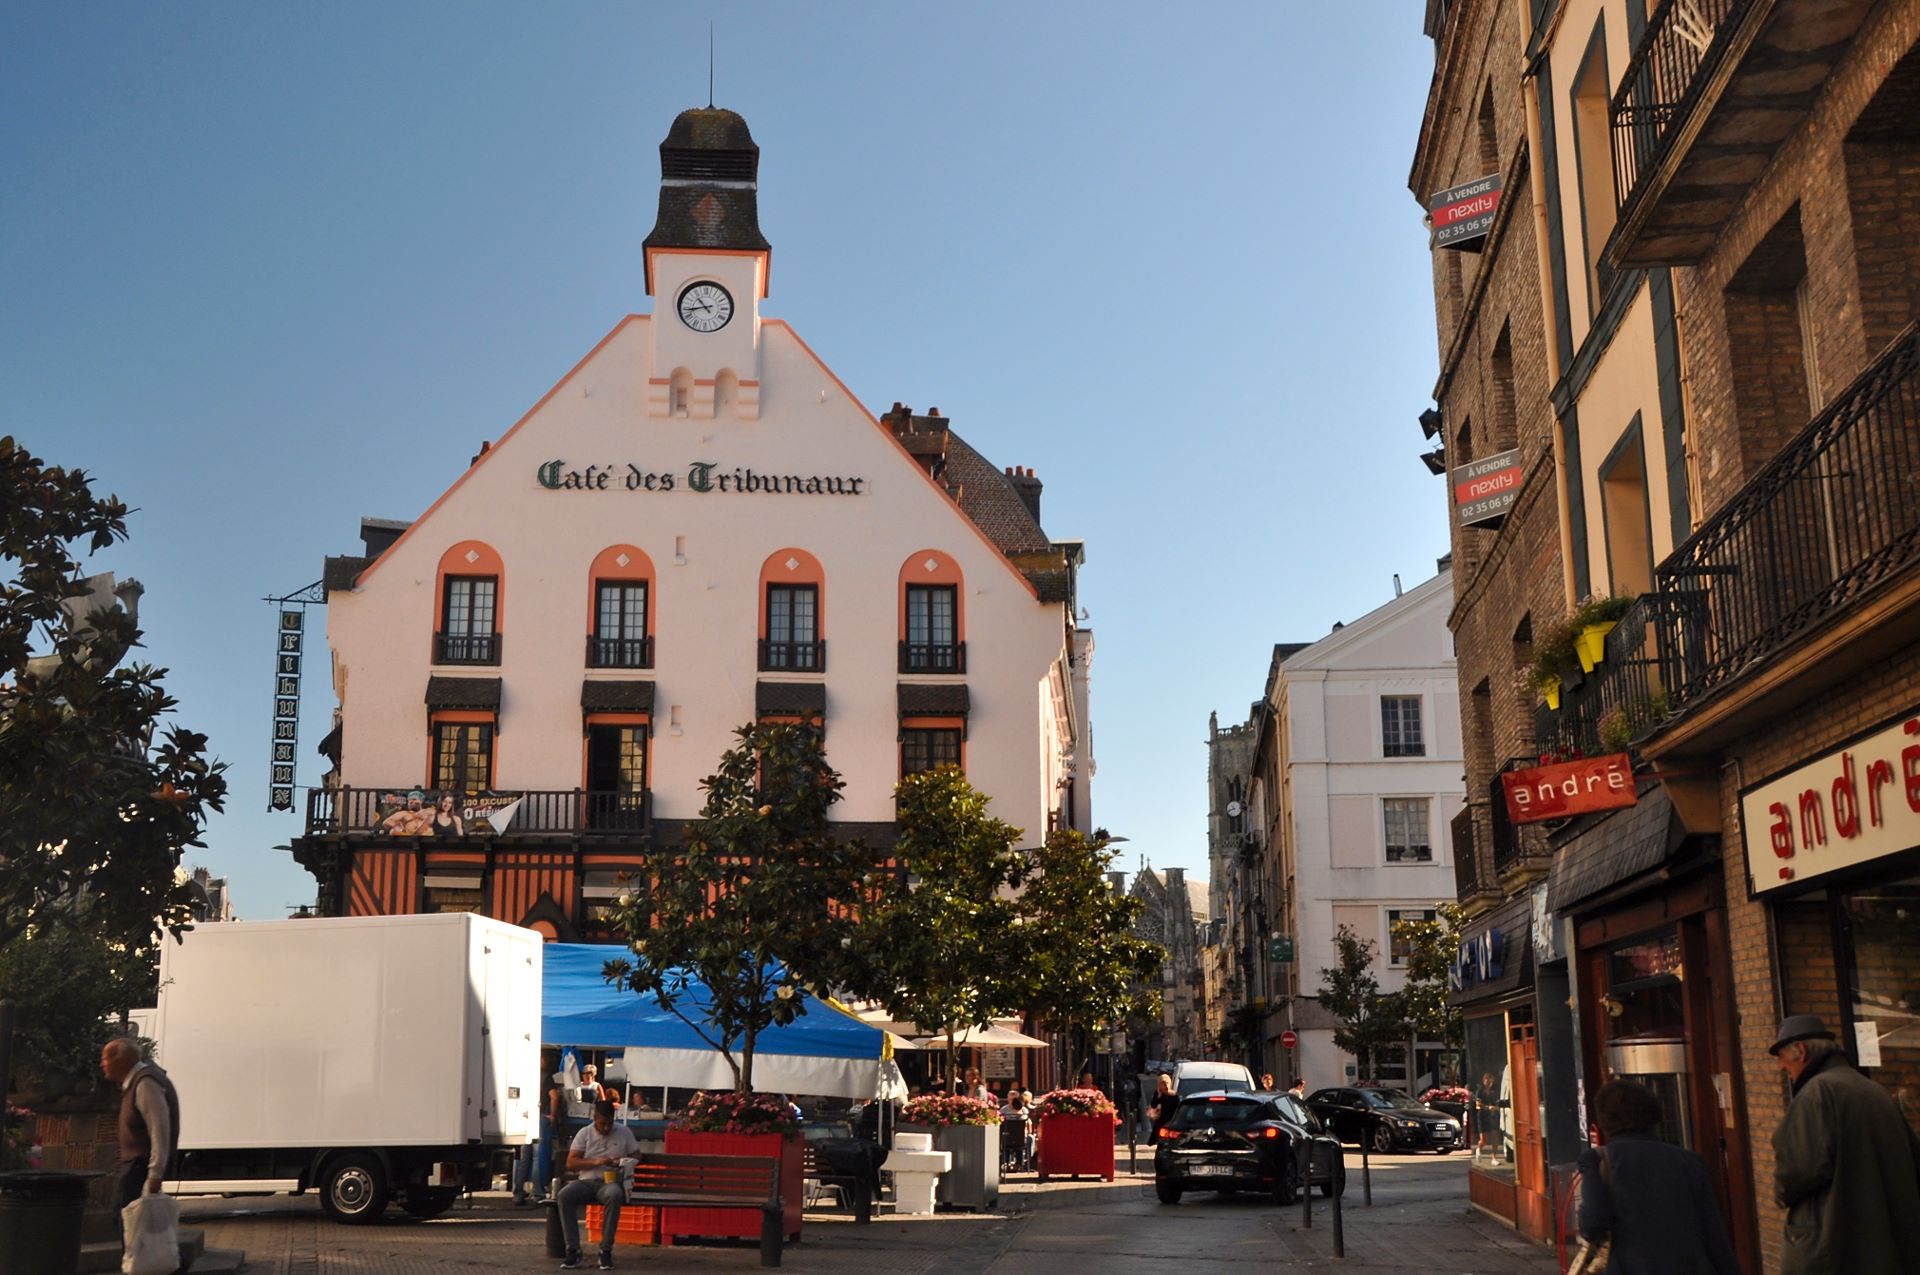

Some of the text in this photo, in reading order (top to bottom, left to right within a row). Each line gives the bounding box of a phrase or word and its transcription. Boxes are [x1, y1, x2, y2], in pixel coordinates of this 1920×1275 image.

[1455, 181, 1492, 200] VENDRE
[1448, 197, 1493, 220] nexity
[1438, 229, 1451, 240] 02
[1453, 225, 1465, 236] 35
[1466, 219, 1480, 231] 06
[1476, 456, 1512, 475] VENDRE
[537, 459, 863, 495] Café des Tribunaux
[1470, 473, 1513, 497] nexity
[1462, 506, 1474, 518] 02
[1475, 502, 1488, 514] 35
[1489, 497, 1502, 510] 06
[273, 613, 299, 805] Tribunaux
